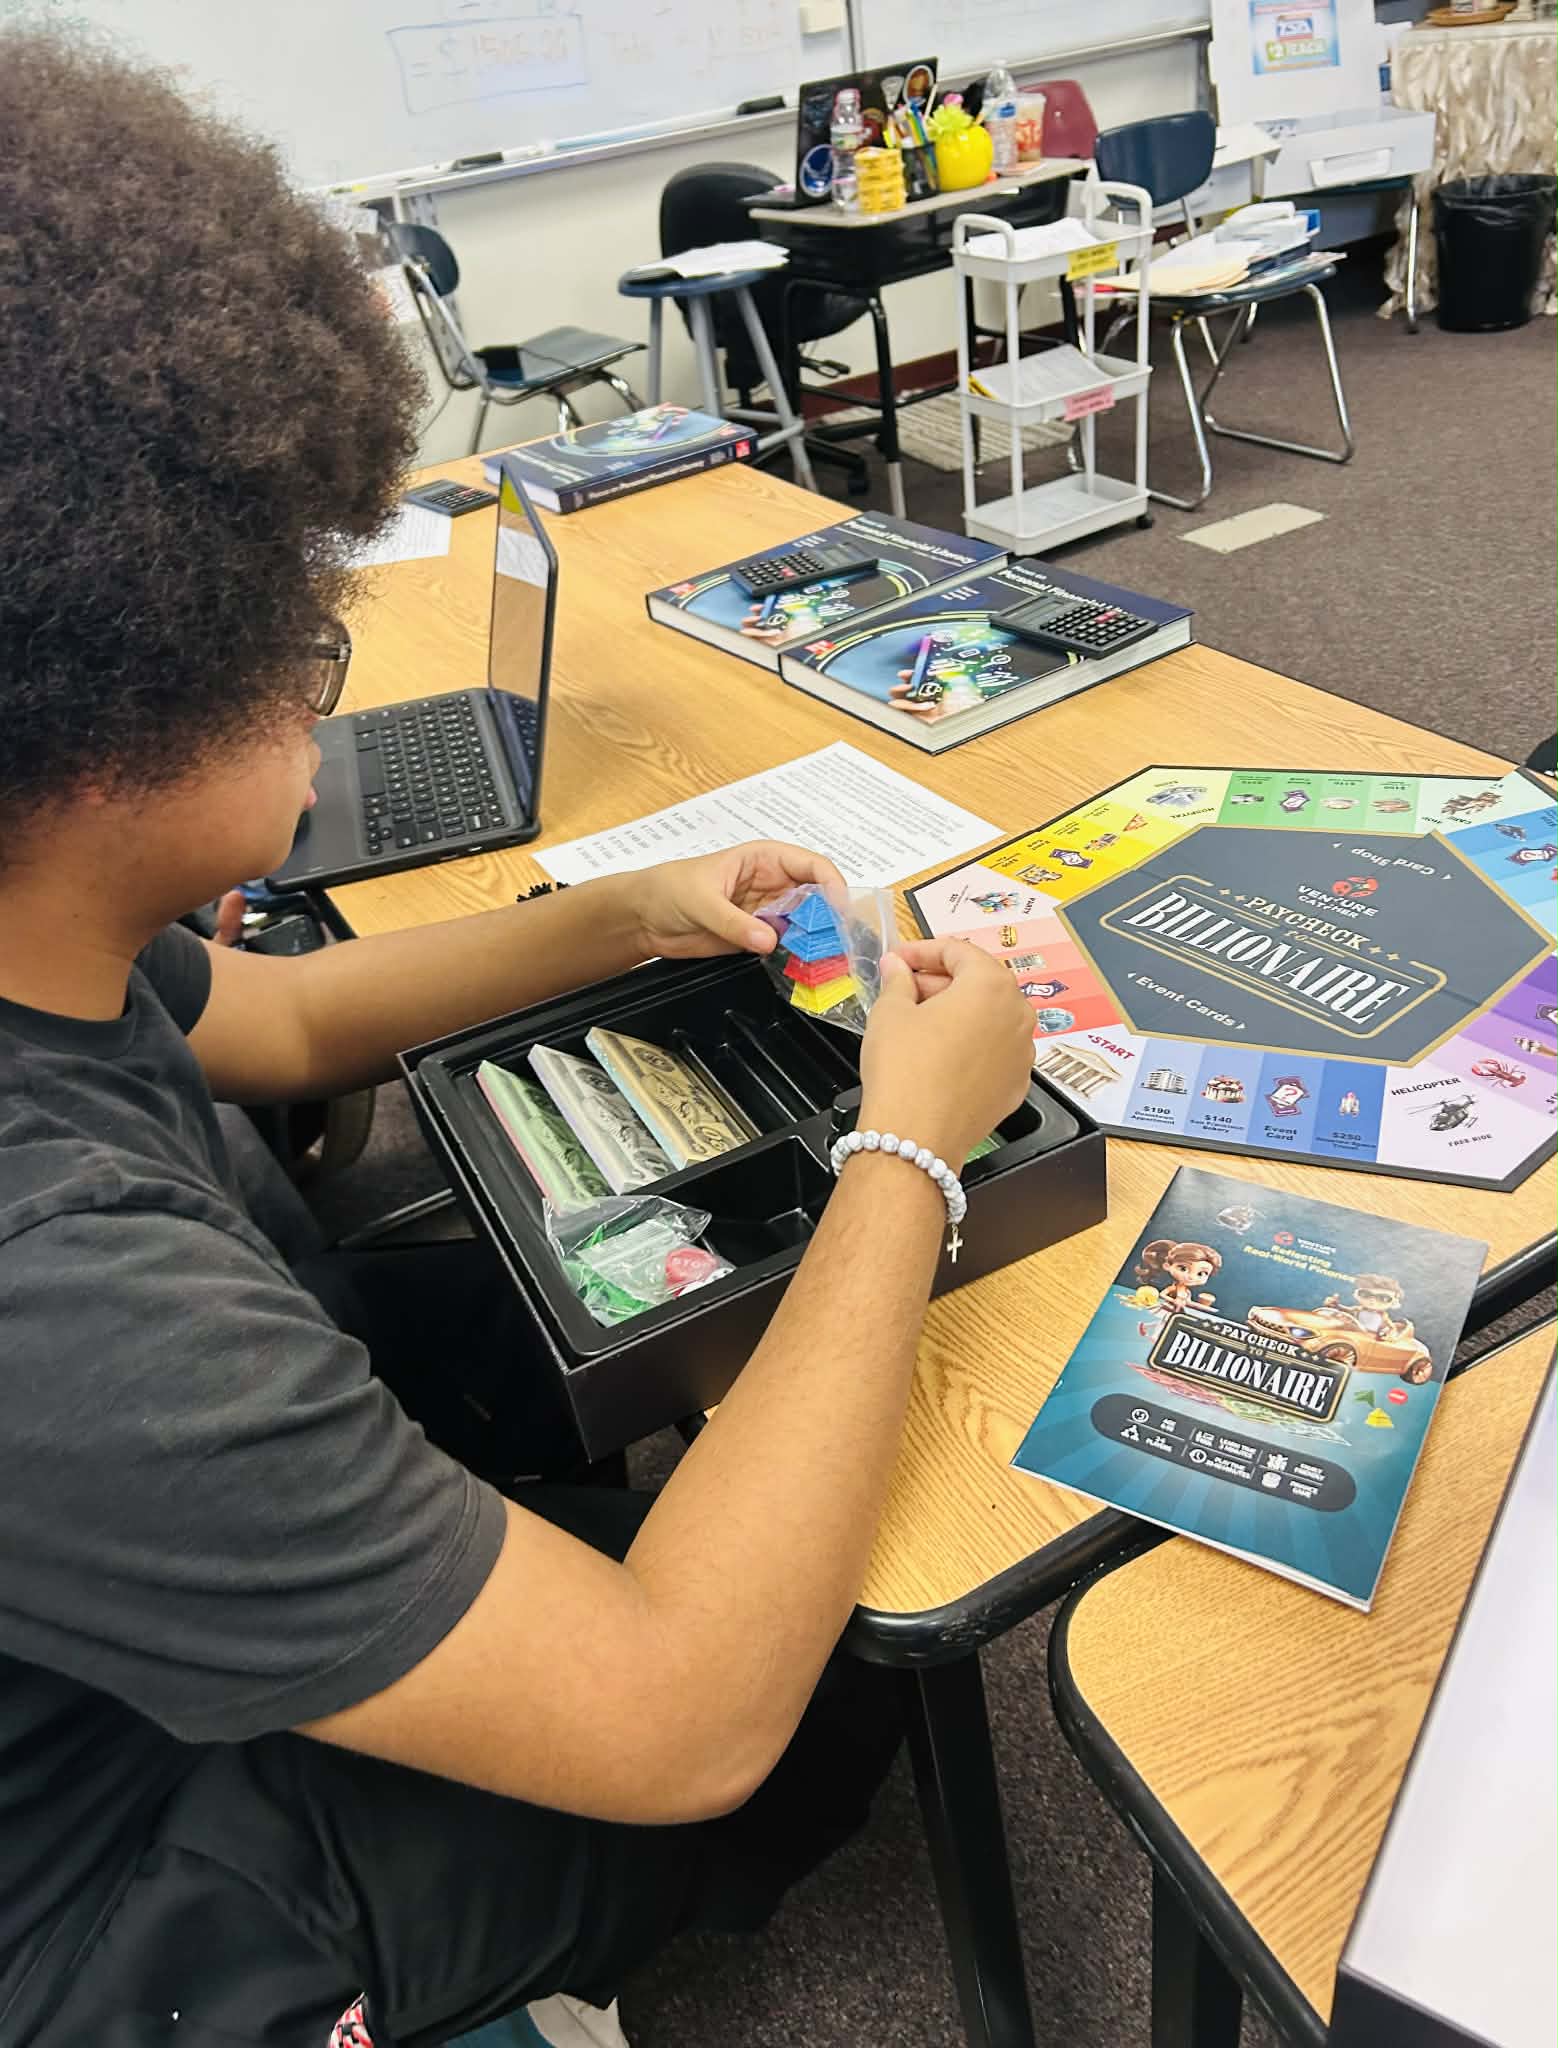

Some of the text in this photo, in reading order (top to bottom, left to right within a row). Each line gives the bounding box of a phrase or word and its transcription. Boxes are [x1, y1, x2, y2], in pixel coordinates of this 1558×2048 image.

[1351, 847, 1436, 876] Card Shop
[1023, 897, 1036, 915] PARTY
[1298, 885, 1379, 917] VENTURE
[1298, 895, 1359, 919] CATCHER
[1243, 896, 1371, 951] PAYCHECK
[1122, 891, 1411, 1025] BILLIONAIRE
[1136, 975, 1237, 1028] Event Cards
[1091, 1036, 1135, 1059] START
[1391, 1077, 1461, 1096] HELICOPTER
[1143, 1105, 1171, 1115] $190
[1204, 1114, 1233, 1124] $140
[1264, 1125, 1298, 1135] Event
[1266, 1132, 1294, 1141] Card
[1448, 1133, 1493, 1147] FREE RIDE
[1243, 1245, 1307, 1270] Real-World
[1271, 1244, 1332, 1268] Reflecting
[1221, 1324, 1299, 1356] PAYCHECK
[1250, 1347, 1263, 1356] TO
[1163, 1330, 1334, 1412] BILLIONAIRE
